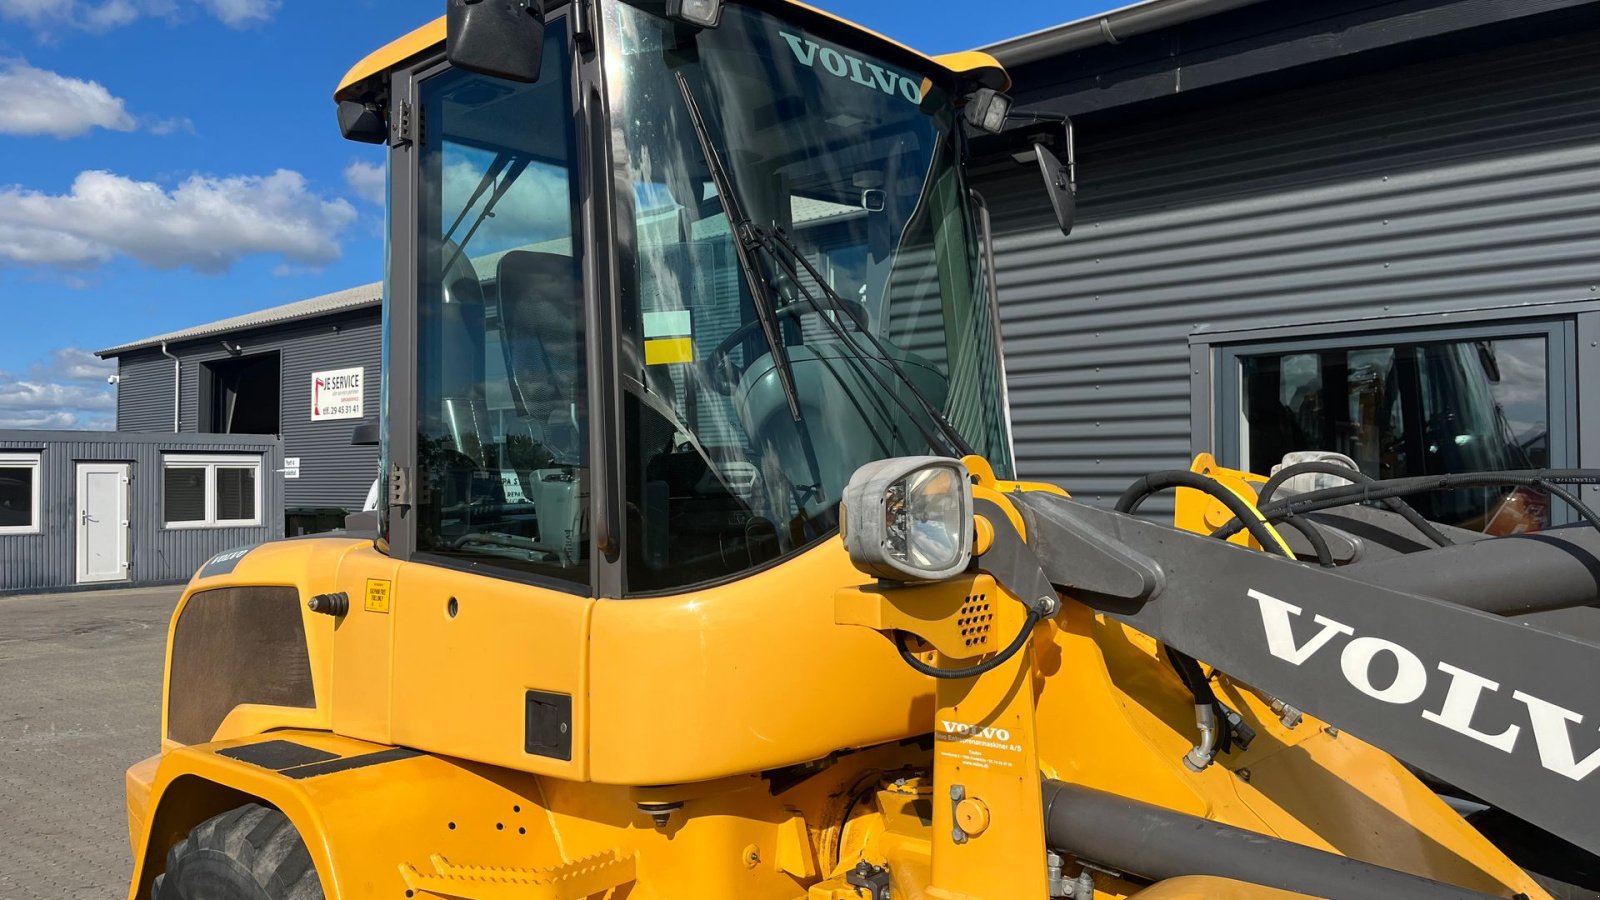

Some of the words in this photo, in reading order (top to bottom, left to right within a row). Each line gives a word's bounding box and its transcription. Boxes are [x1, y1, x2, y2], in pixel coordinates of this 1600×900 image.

[778, 30, 922, 105] VOLVO
[323, 377, 331, 391] JE
[331, 374, 359, 390] SERVICE
[330, 406, 338, 415] 29
[338, 405, 345, 414] 45
[345, 405, 352, 414] 31
[352, 404, 359, 413] 41
[1247, 588, 1600, 782] VOLV
[941, 720, 1010, 742] VOLVO
[1009, 744, 1022, 753] A/S
